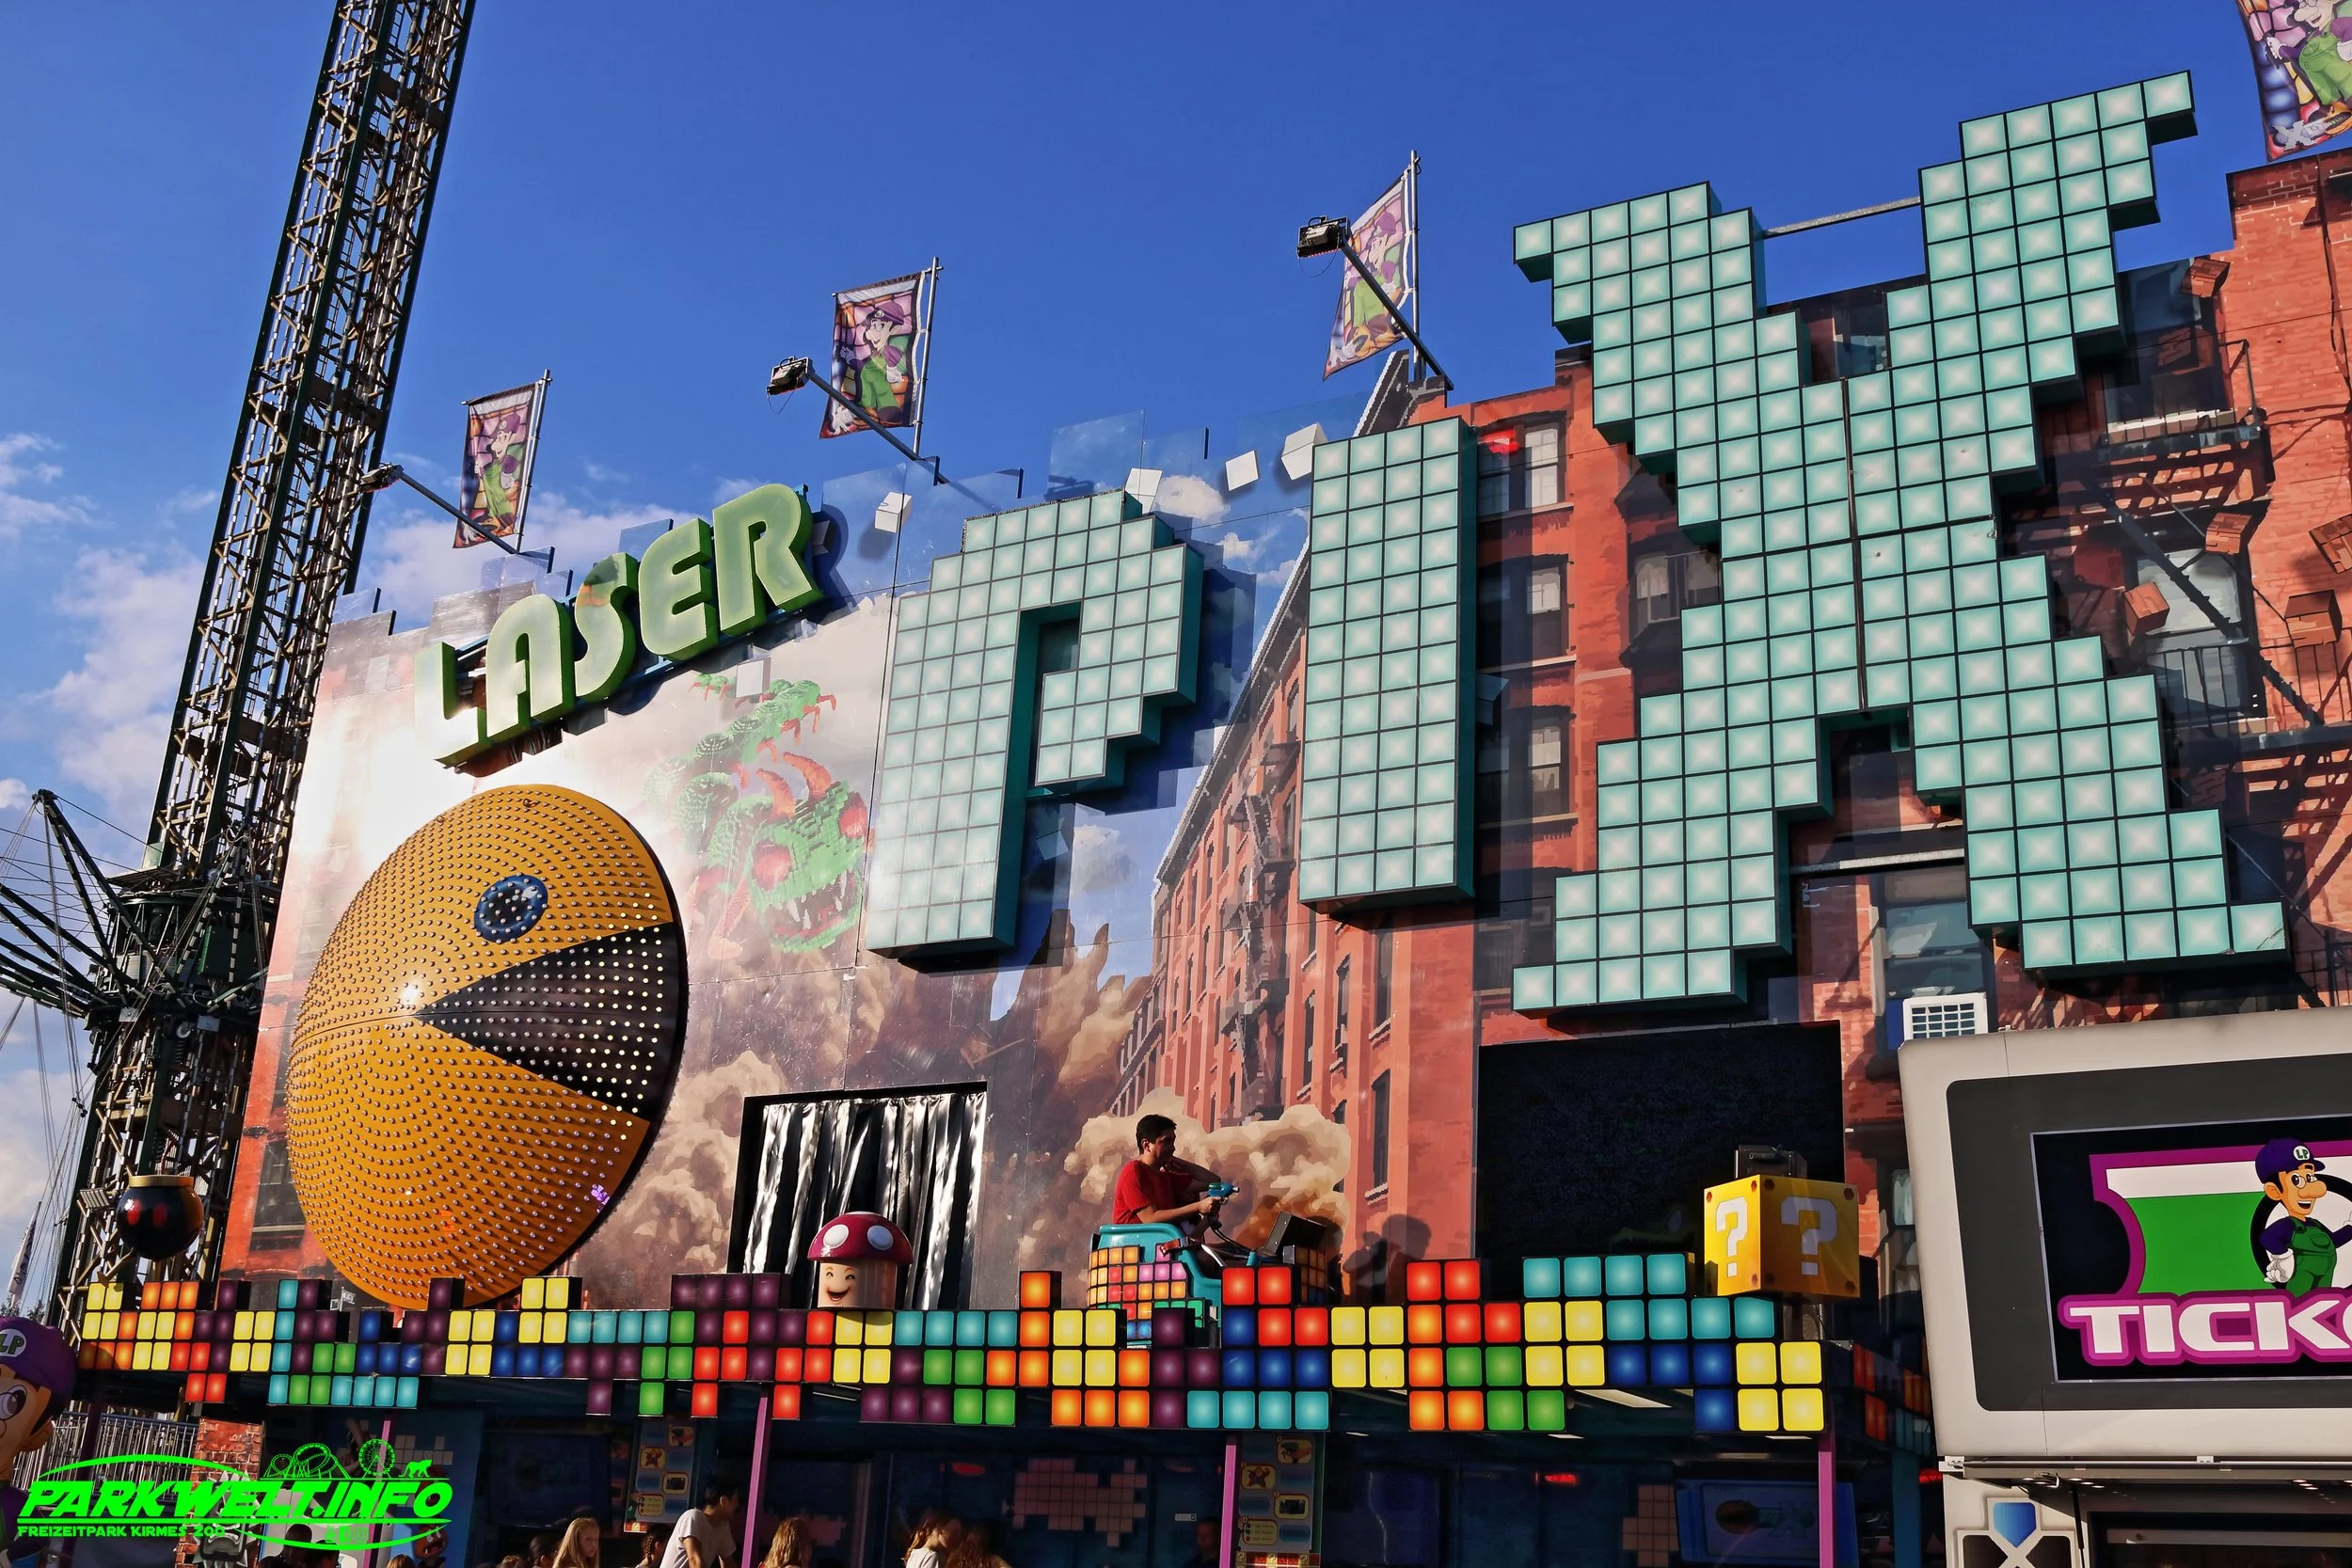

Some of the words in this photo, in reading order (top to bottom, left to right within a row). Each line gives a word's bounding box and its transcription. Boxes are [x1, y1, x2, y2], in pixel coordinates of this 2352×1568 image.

[414, 483, 826, 767] LASER
[866, 71, 2287, 1020] PIX
[2296, 1148, 2310, 1161] LP
[2065, 1296, 2352, 1357] TICK
